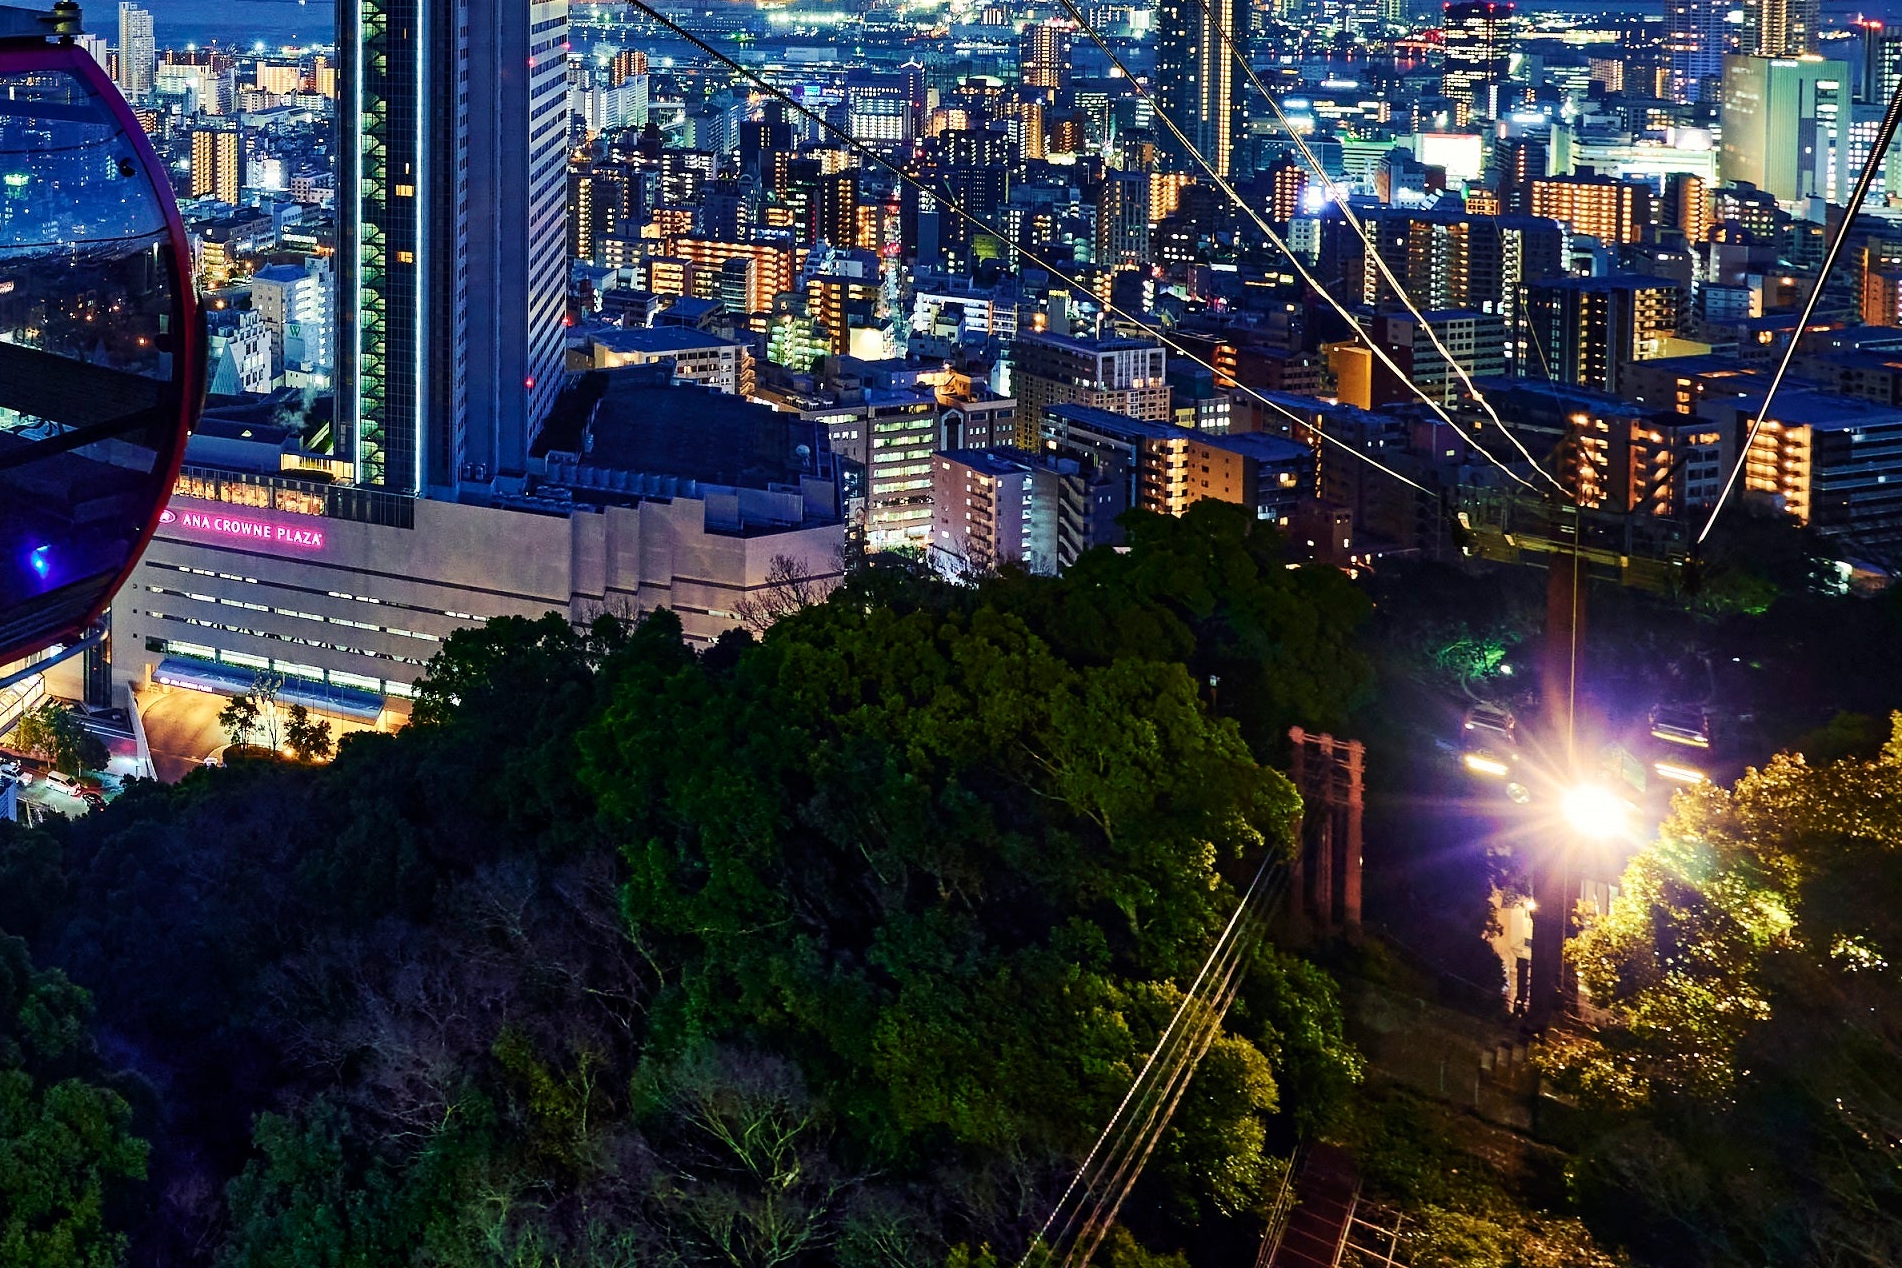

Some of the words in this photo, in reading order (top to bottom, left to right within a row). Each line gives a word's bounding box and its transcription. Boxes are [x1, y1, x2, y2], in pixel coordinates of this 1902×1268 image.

[182, 513, 210, 529] ANA
[213, 518, 272, 538] CROWNE
[276, 527, 321, 546] PLAZA
